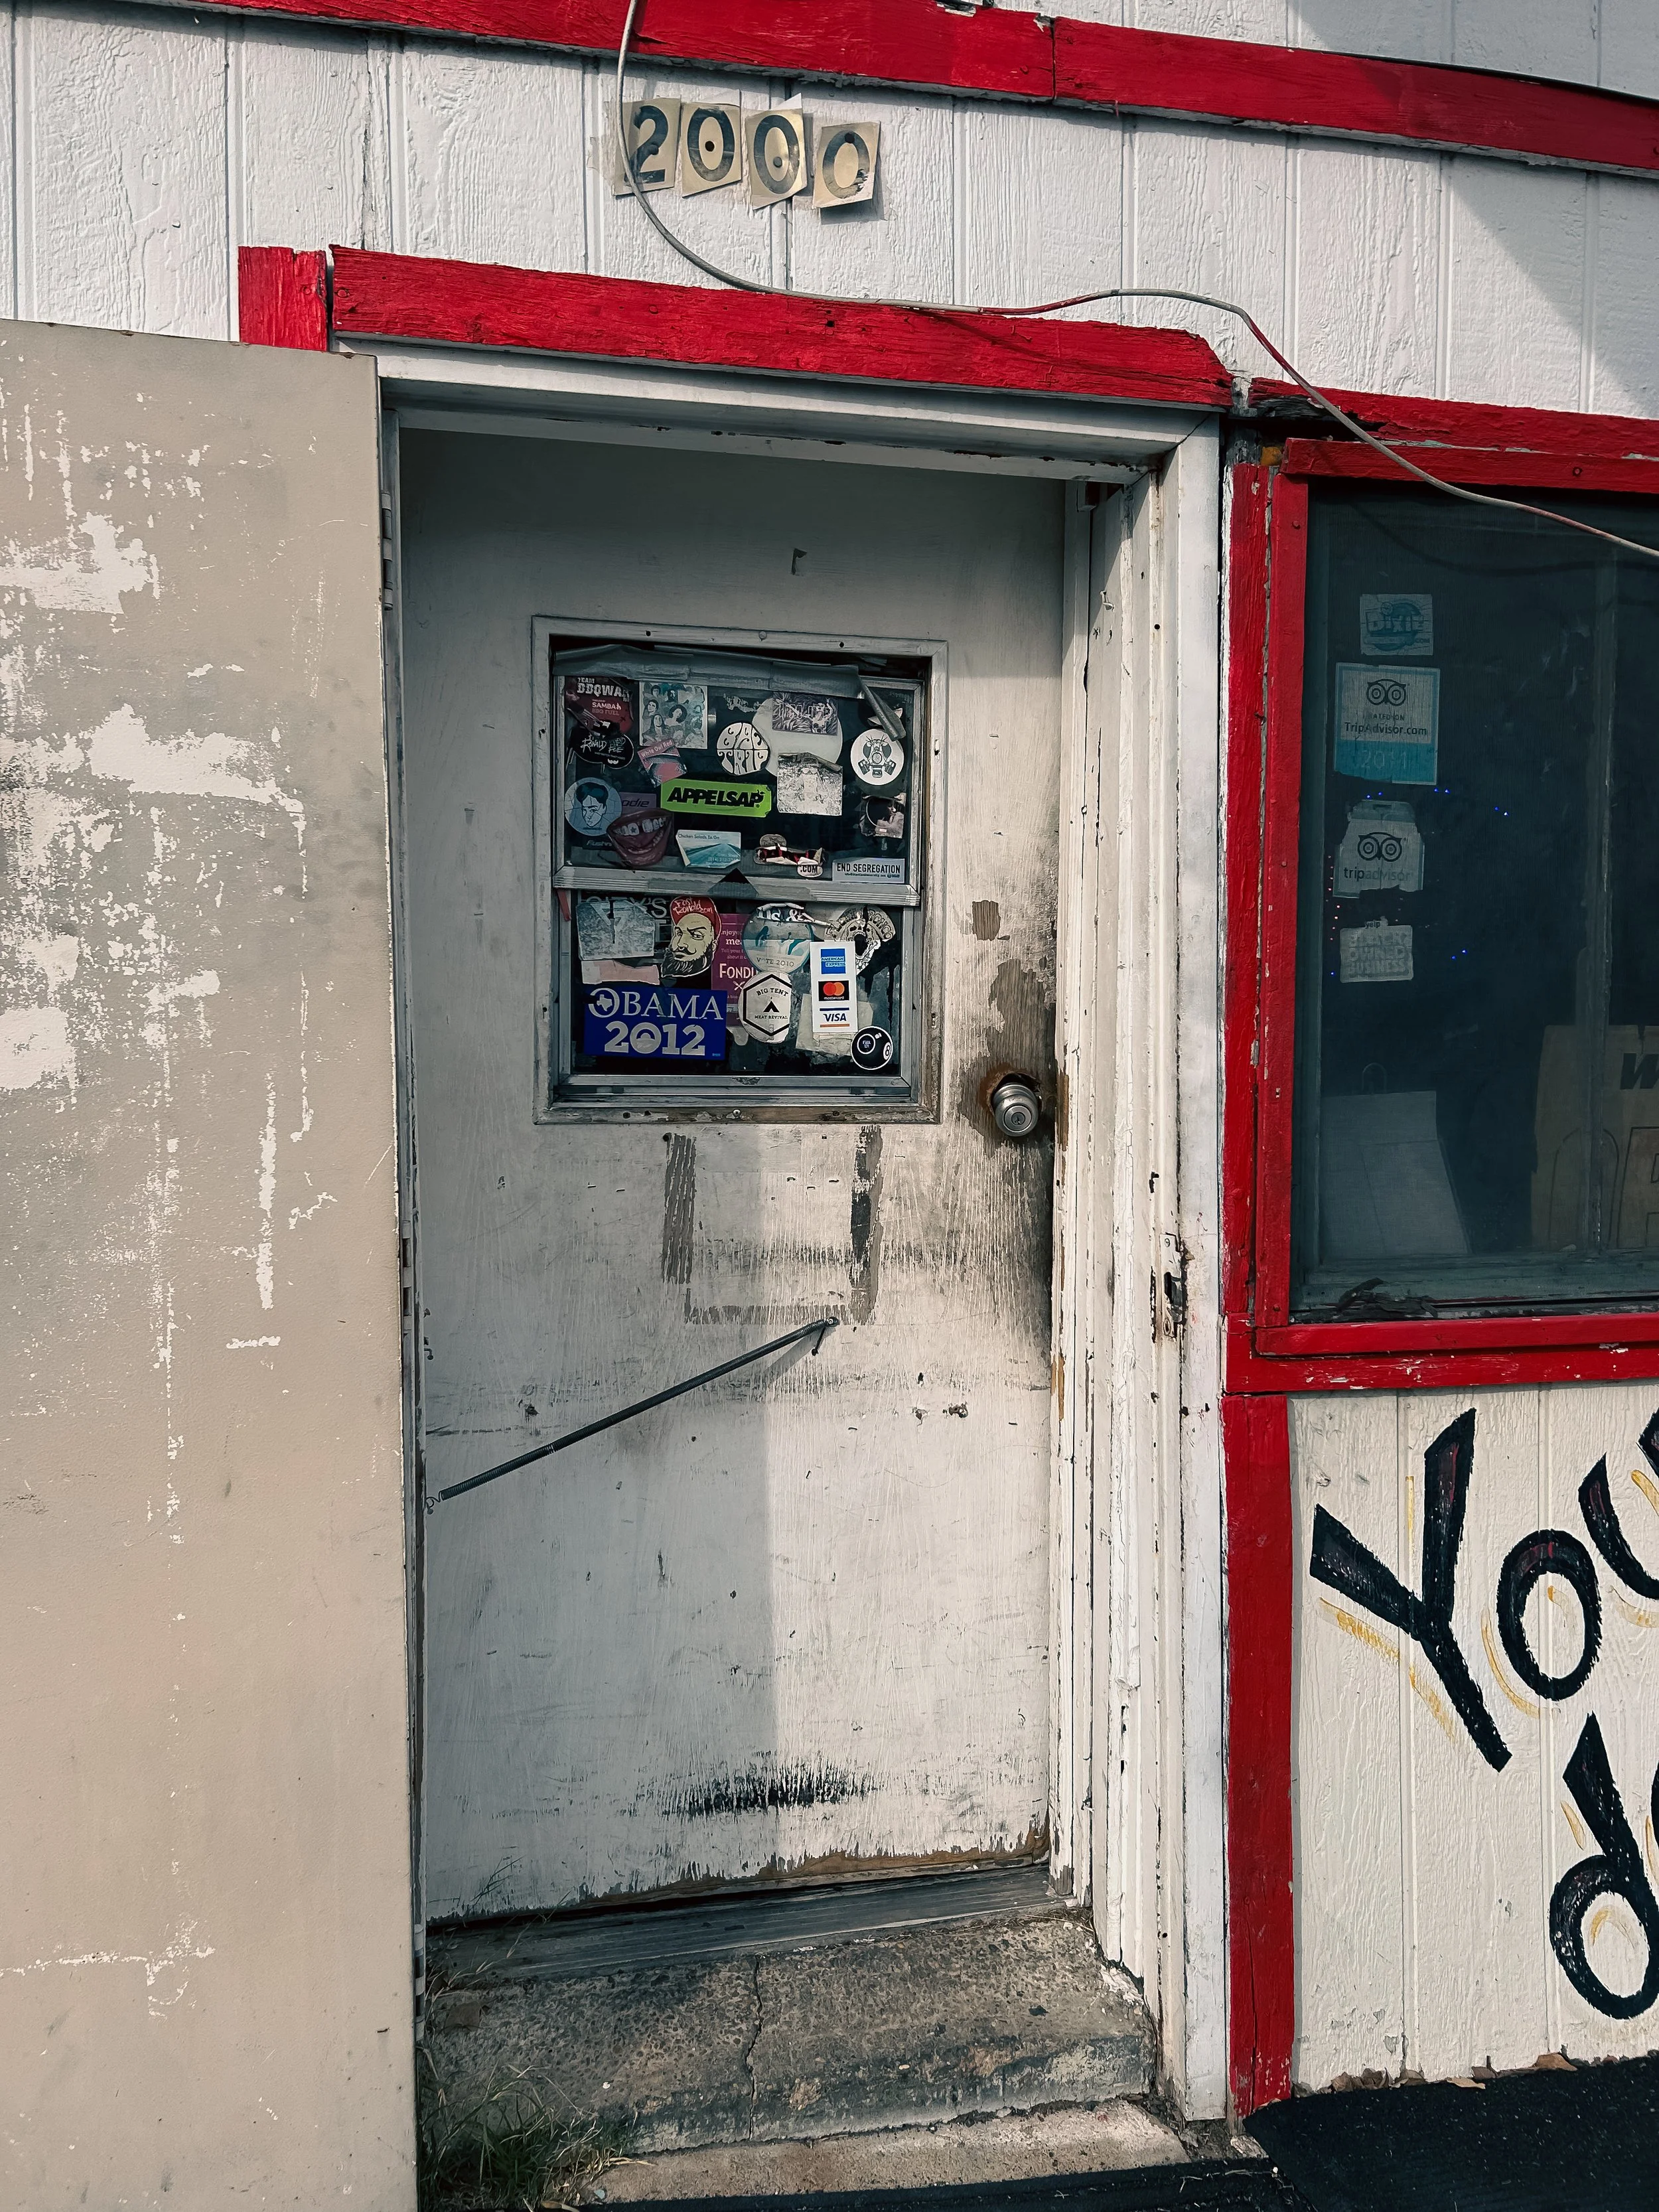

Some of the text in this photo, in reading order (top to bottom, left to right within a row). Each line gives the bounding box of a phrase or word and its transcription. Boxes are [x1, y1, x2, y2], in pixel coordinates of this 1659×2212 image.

[624, 105, 870, 198] 2000
[592, 701, 616, 710] SAMBA
[1344, 721, 1427, 735] TripAdvisor.com
[641, 739, 673, 759] White Owl Red
[667, 787, 764, 808] APPELSAP
[837, 863, 901, 873] END SEGREGATION
[1344, 867, 1411, 883] tripadvisor
[1364, 921, 1381, 929] yelp
[770, 988, 789, 997] TENT
[588, 988, 724, 1020] OBAMA
[823, 1013, 847, 1022] VISA
[604, 1021, 705, 1056] 2012
